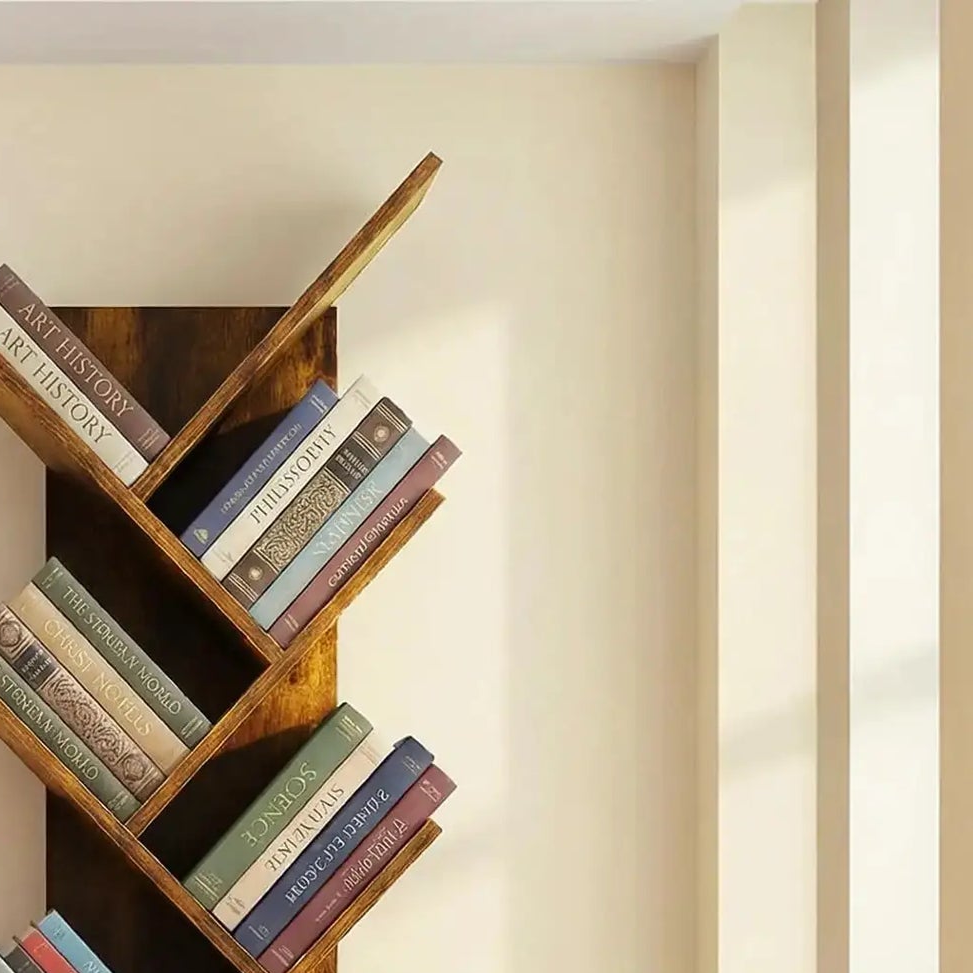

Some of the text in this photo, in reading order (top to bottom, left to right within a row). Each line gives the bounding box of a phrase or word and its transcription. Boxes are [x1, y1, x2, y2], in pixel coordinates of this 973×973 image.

[18, 304, 134, 417] ART HISTORY
[33, 362, 112, 443] HISTORY
[63, 586, 87, 616] THE
